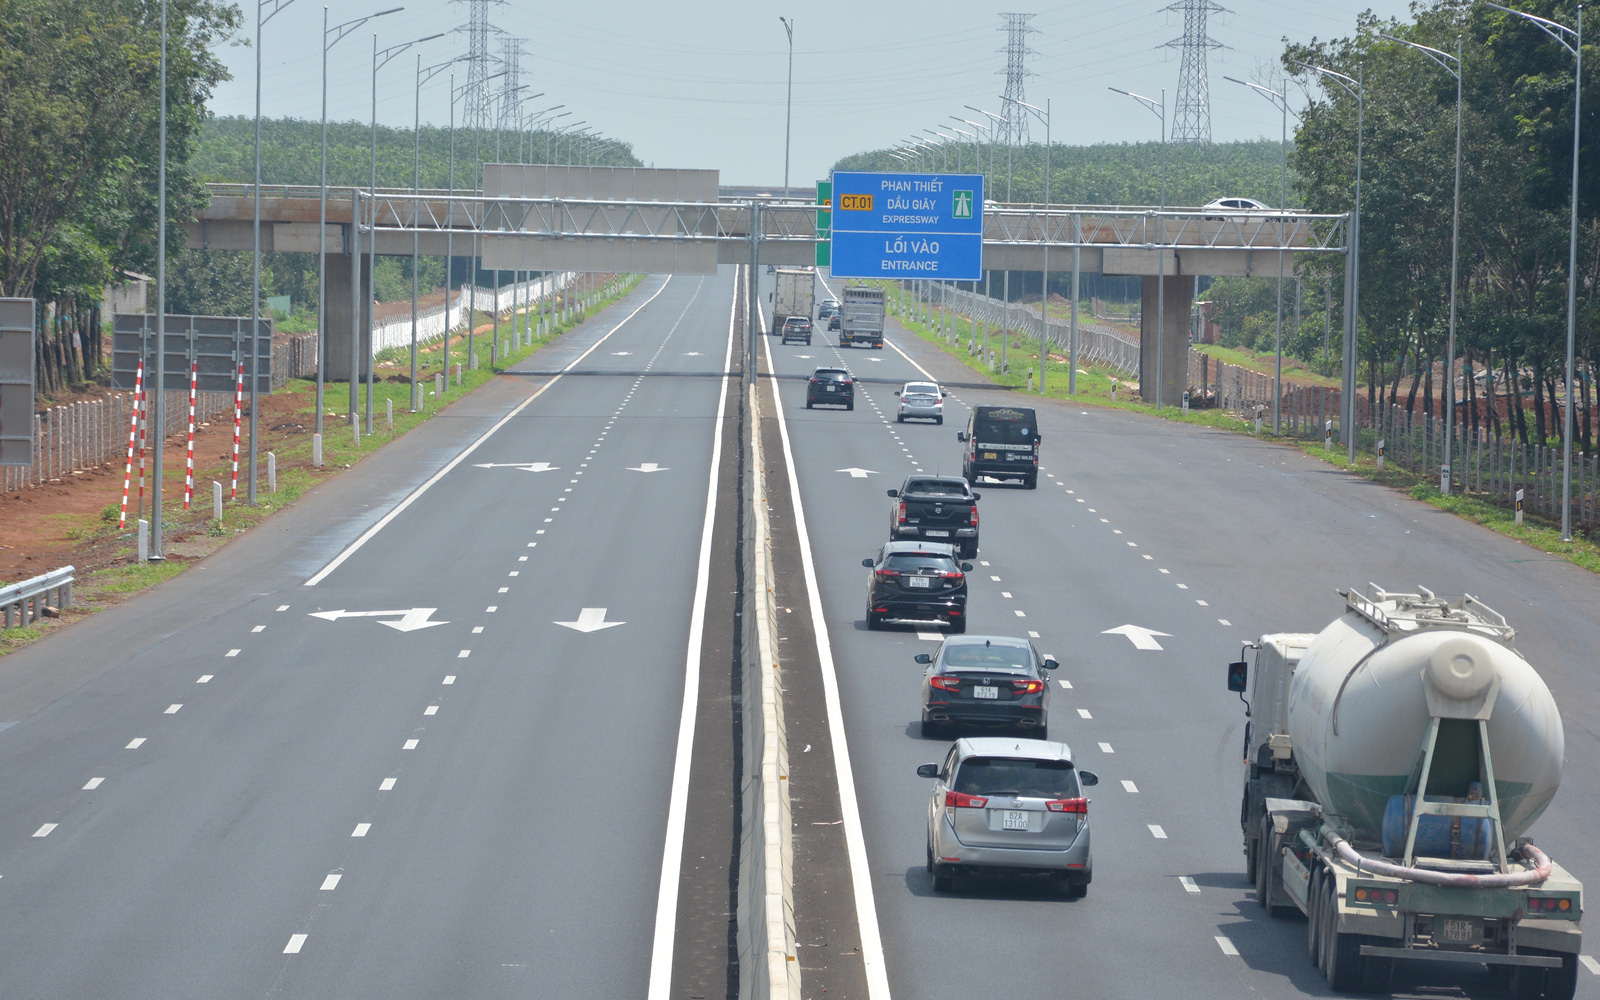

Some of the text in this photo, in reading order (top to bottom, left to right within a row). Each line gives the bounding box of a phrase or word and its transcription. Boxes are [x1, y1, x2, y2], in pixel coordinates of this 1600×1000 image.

[881, 177, 943, 192] PHAN THIẾT
[842, 196, 872, 209] CT.01
[887, 195, 937, 211] DẦU GIÂY
[882, 215, 939, 224] EXPRESSWAY
[885, 235, 939, 254] LỐI VÀO
[881, 260, 939, 271] ENTRANCE
[1009, 811, 1023, 820] 62A
[1005, 819, 1028, 829] 131.00
